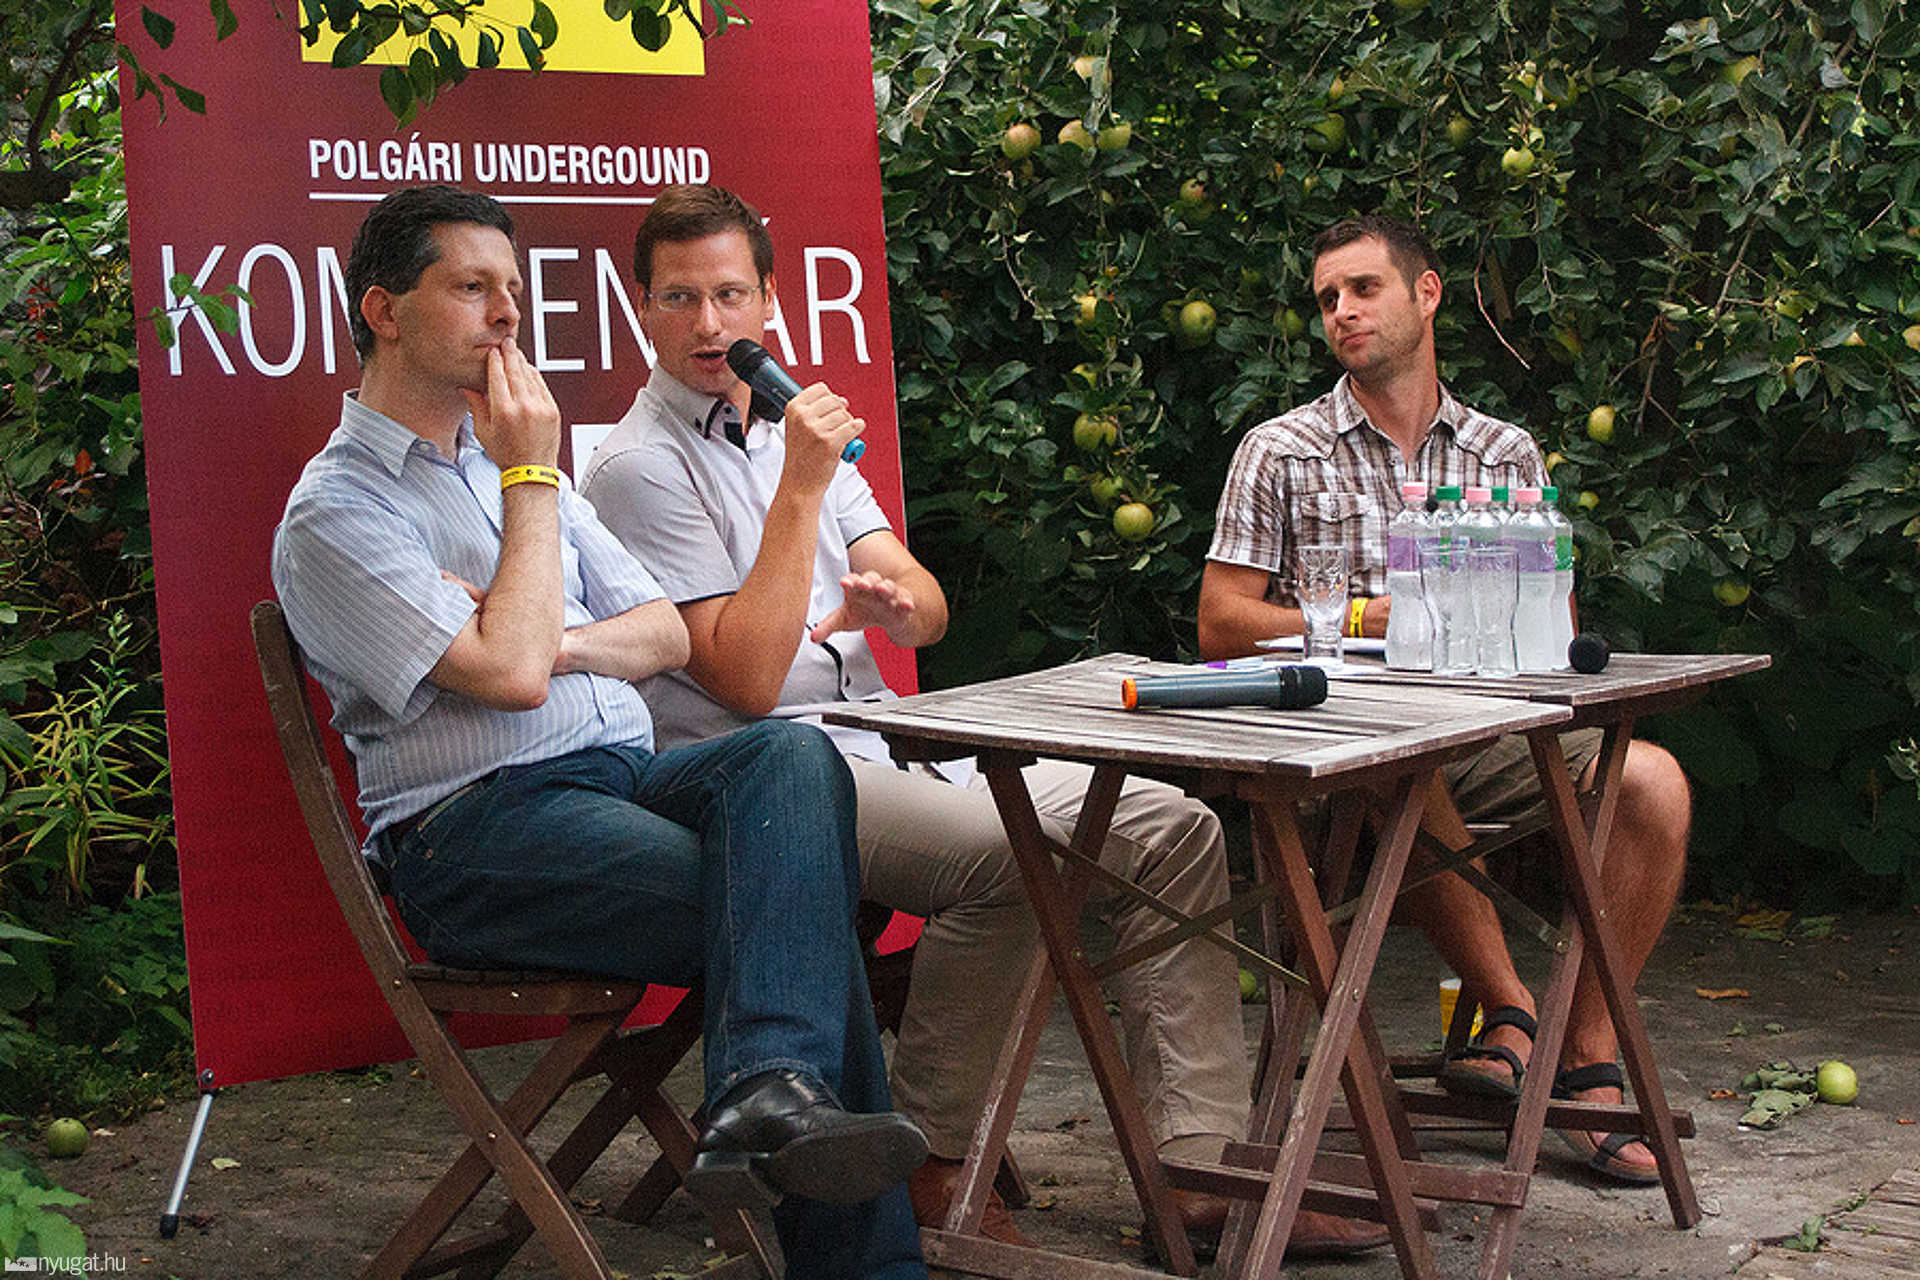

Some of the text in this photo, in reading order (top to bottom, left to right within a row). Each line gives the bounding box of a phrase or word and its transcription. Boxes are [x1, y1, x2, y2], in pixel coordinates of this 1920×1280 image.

[308, 131, 710, 186] POLGÁRI UNDERGOUND
[161, 217, 871, 377] KOENR
